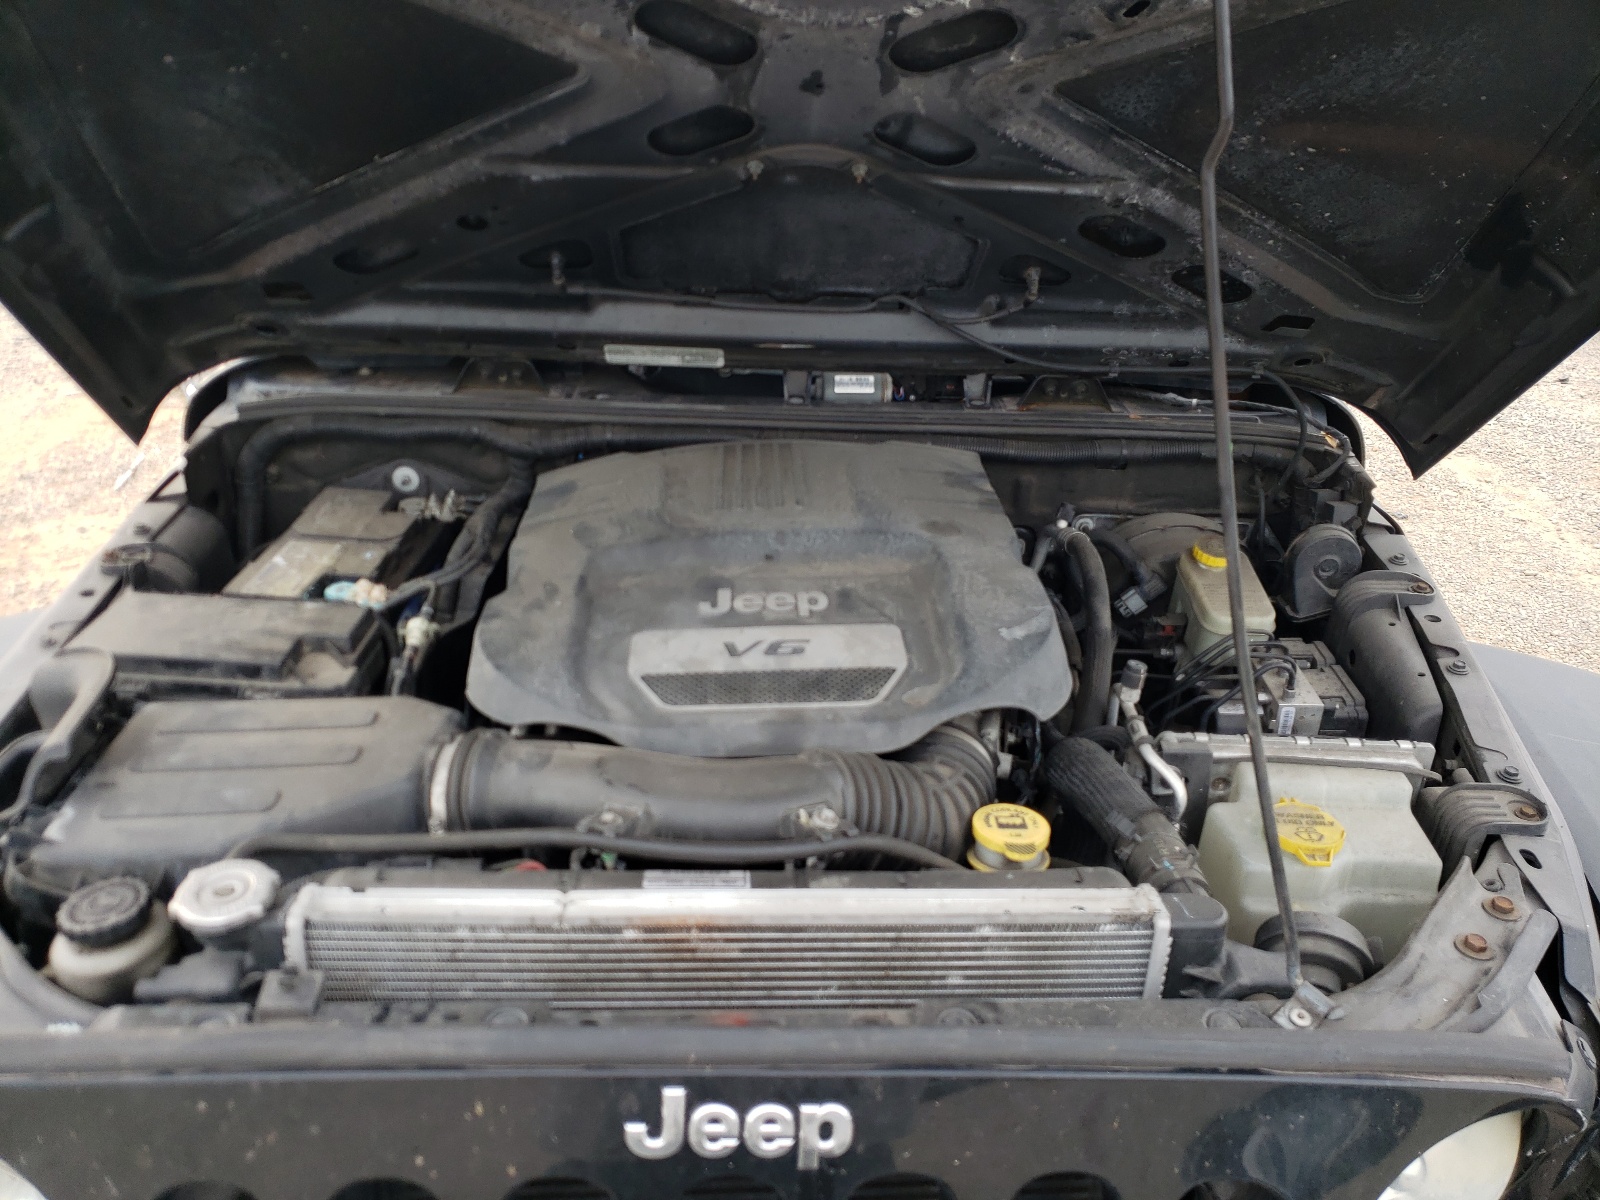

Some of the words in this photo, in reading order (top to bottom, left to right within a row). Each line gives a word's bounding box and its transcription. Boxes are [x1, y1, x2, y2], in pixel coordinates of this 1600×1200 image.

[698, 587, 829, 617] Jeep
[723, 639, 810, 656] V6
[623, 1085, 854, 1170] Jeep
